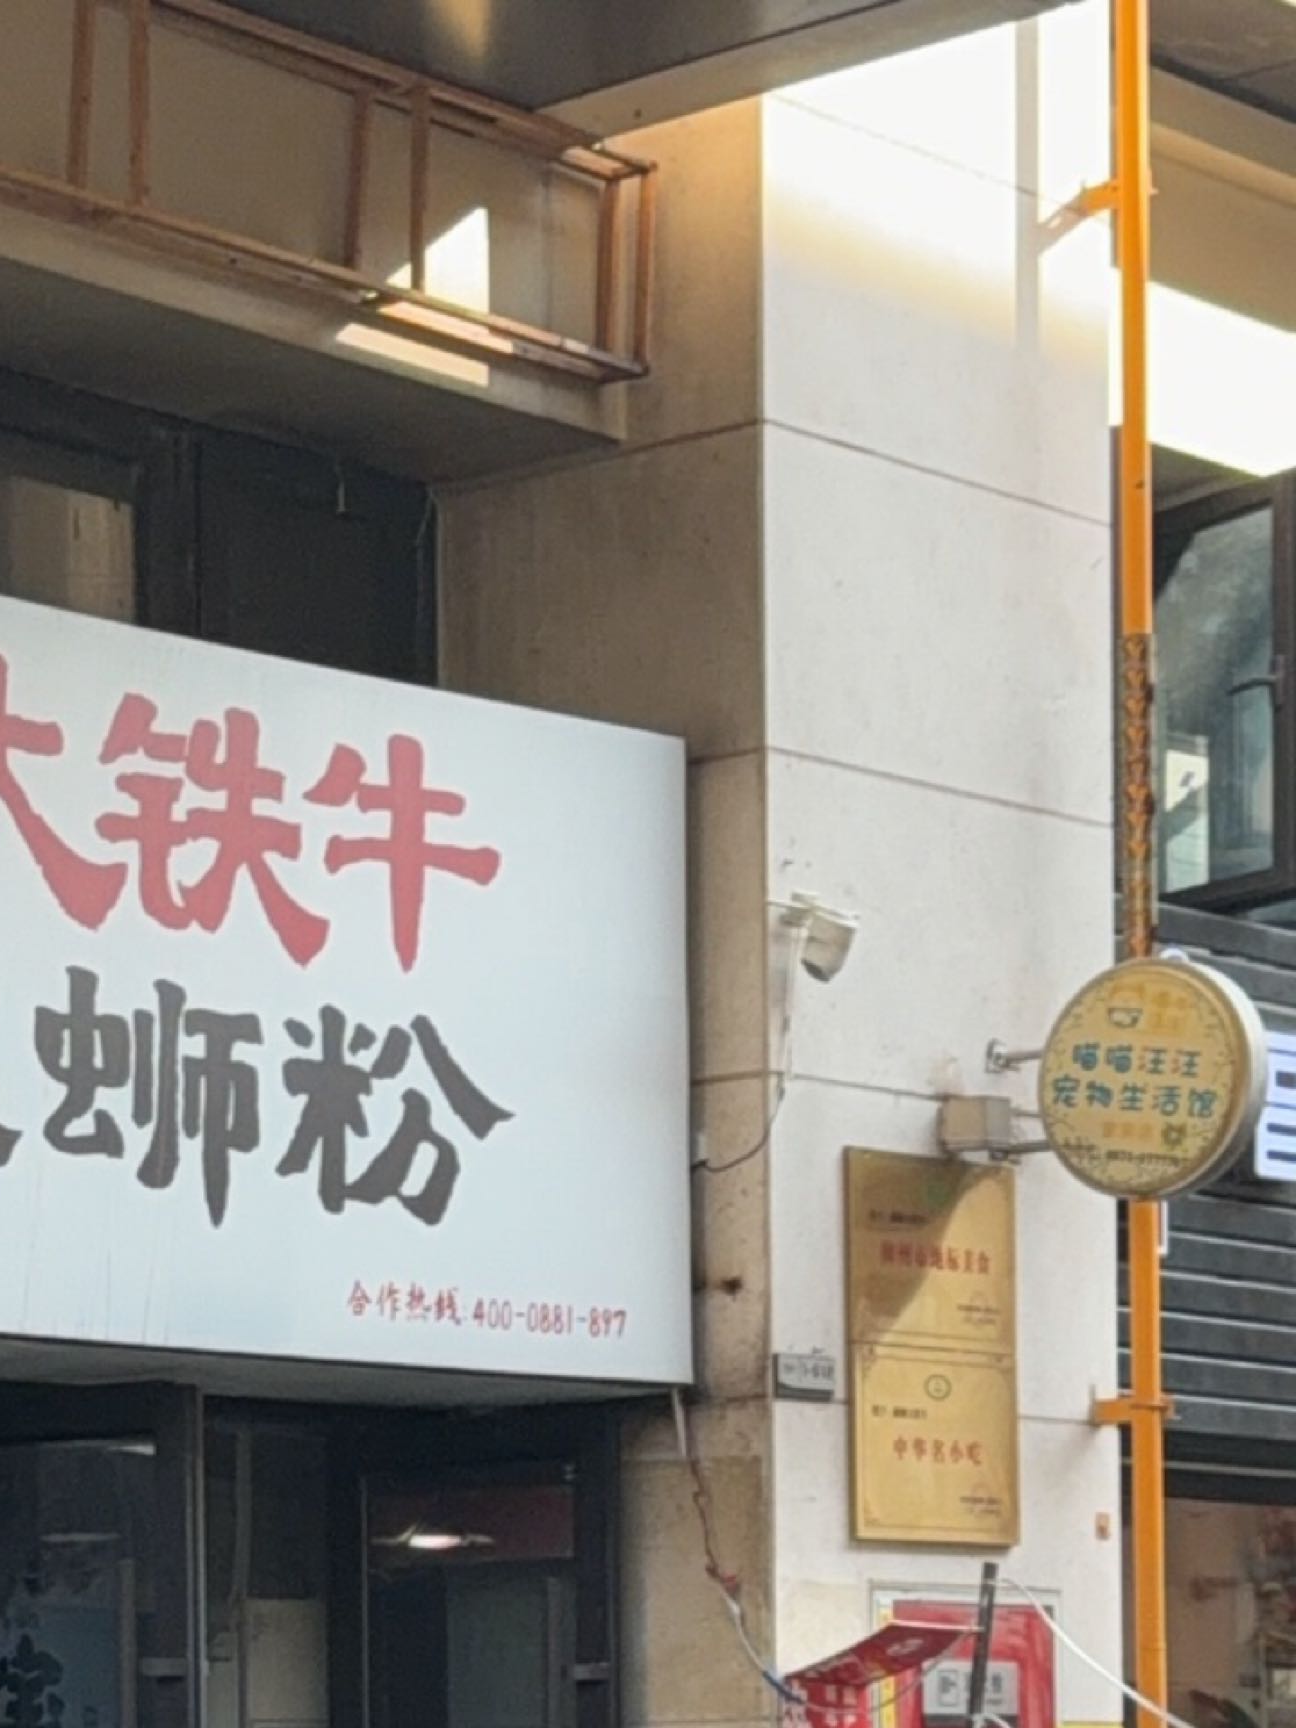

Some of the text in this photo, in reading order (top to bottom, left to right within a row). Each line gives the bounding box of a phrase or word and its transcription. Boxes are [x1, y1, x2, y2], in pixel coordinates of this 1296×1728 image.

[1072, 1042, 1202, 1080] 喵喵汪汪
[1051, 1074, 1219, 1119] 宠物生活馆
